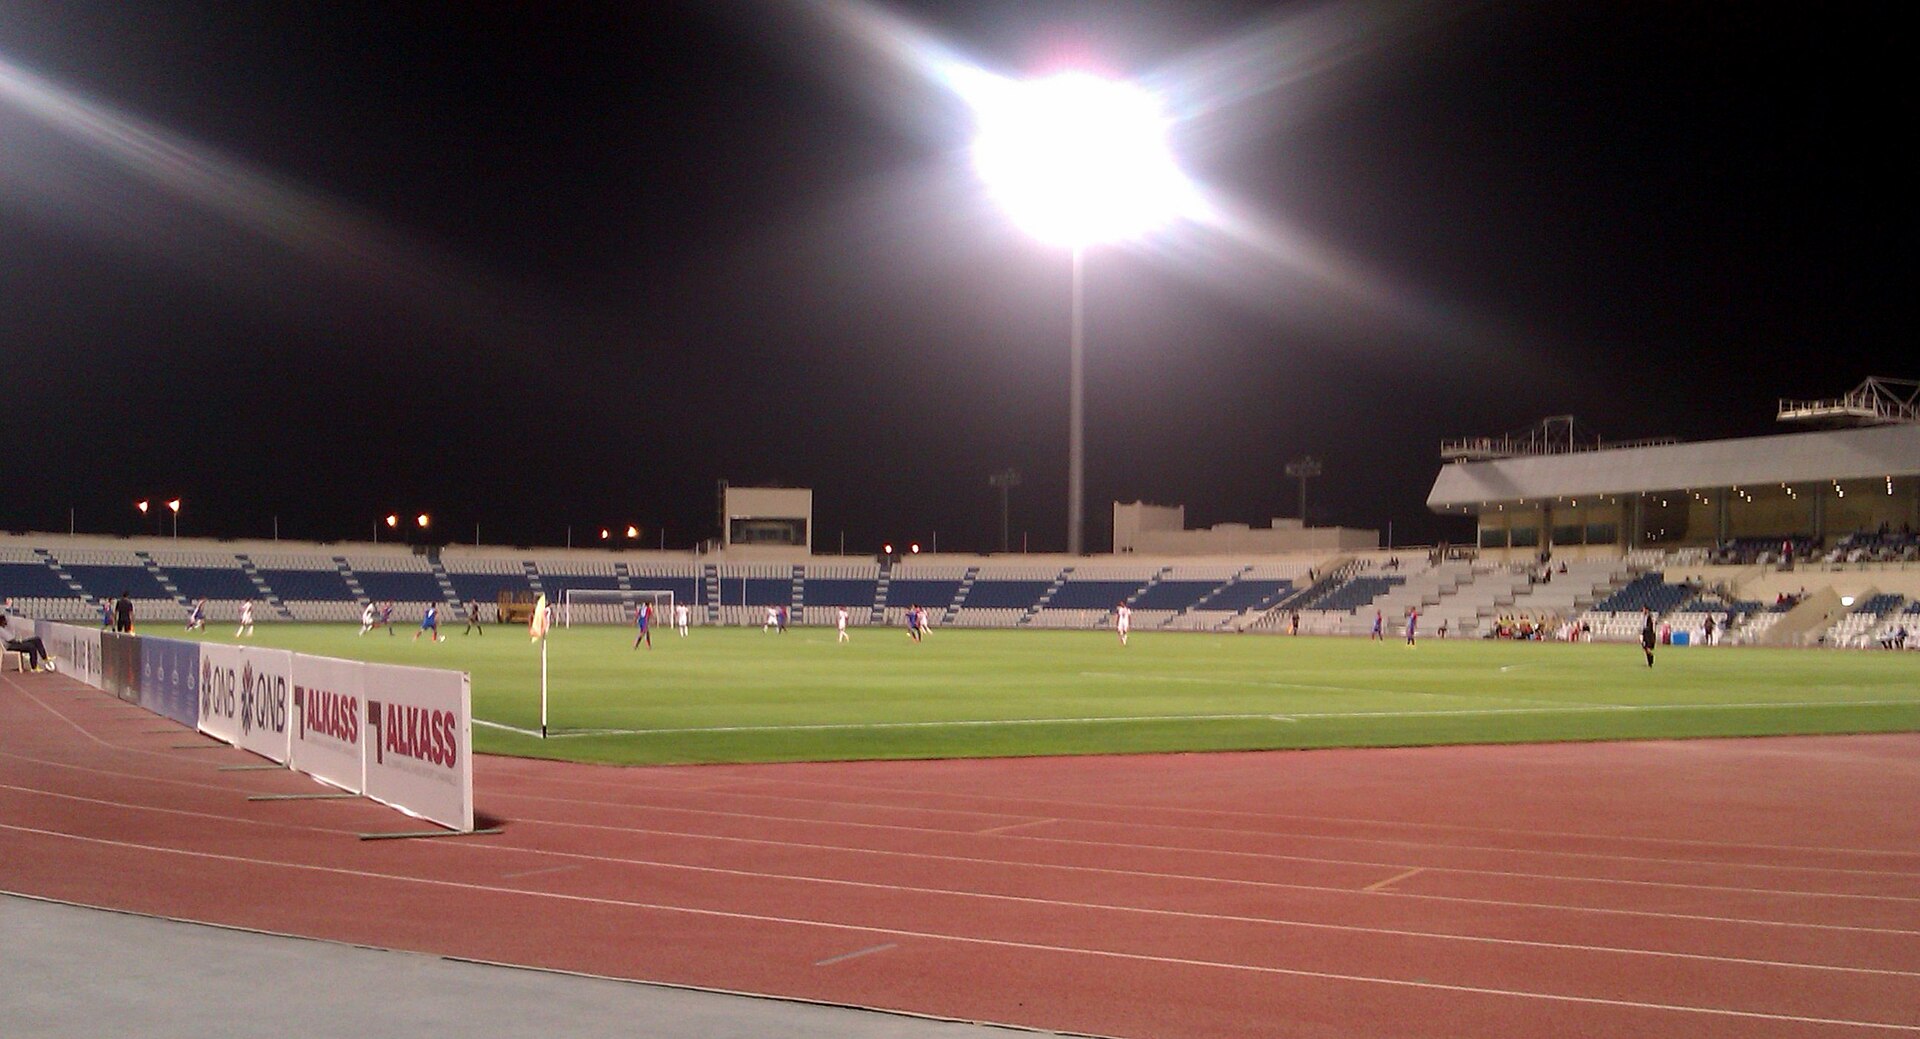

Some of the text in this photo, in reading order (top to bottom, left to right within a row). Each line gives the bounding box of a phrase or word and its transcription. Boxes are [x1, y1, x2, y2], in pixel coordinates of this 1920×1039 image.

[213, 665, 235, 718] QNB
[256, 673, 286, 733] QNB
[307, 688, 358, 744] ALKASS
[386, 703, 457, 768] ALKASS
